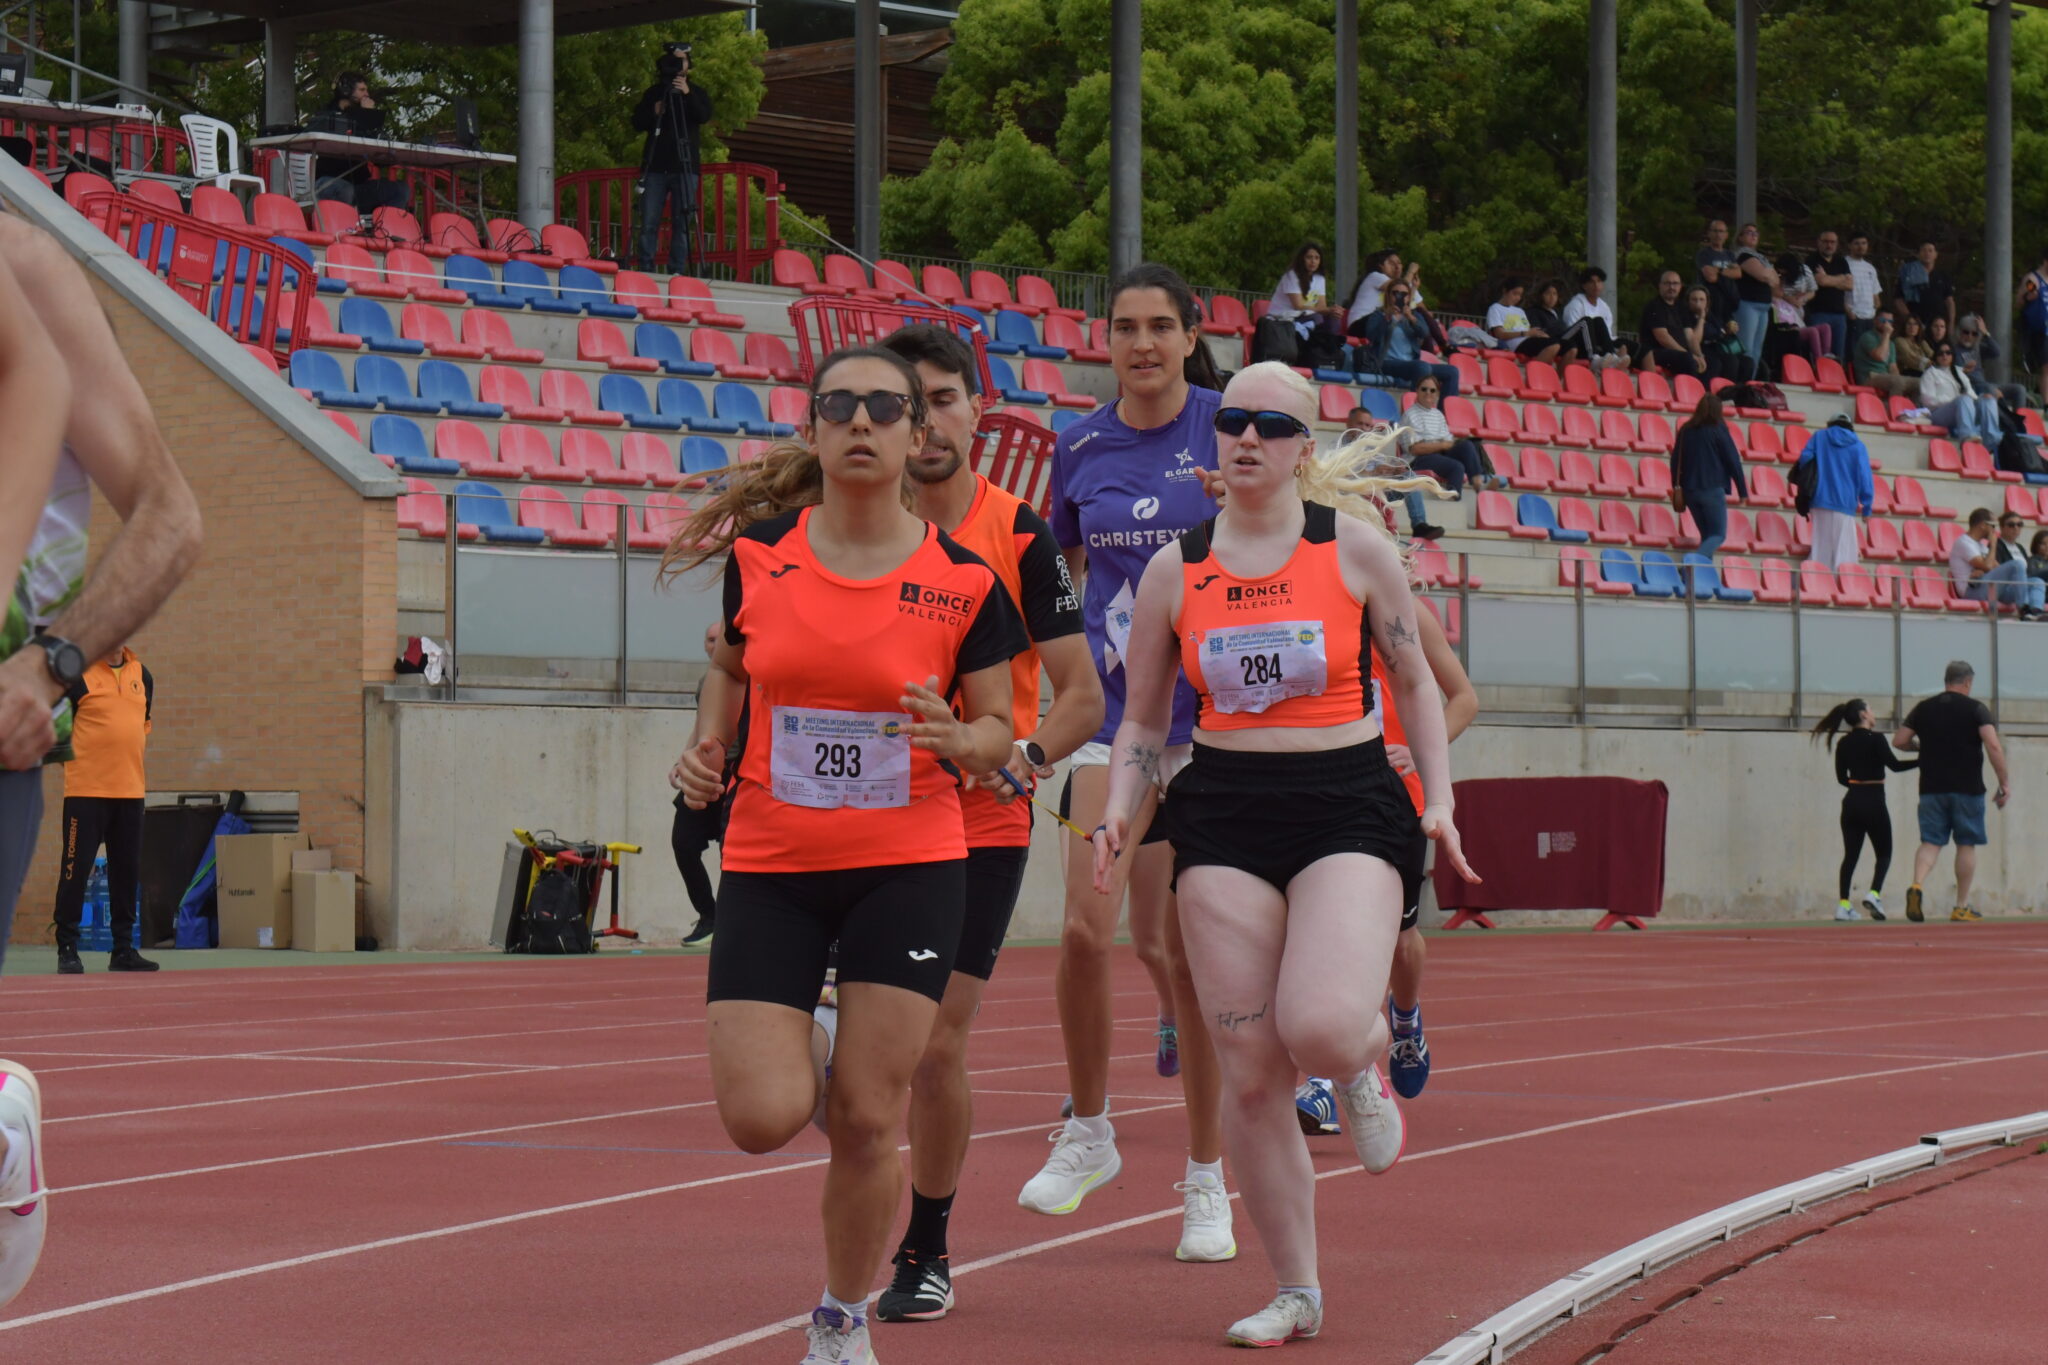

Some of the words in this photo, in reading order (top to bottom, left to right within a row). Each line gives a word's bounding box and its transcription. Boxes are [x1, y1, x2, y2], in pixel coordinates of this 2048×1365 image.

[1165, 470, 1175, 478] EL
[1245, 583, 1289, 598] ONCE
[923, 590, 971, 613] ONCE
[1227, 598, 1292, 611] VALENCIA
[898, 603, 963, 628] VALENCI
[1250, 630, 1291, 639] INTERNACIONAL
[1240, 653, 1283, 686] 284
[784, 714, 799, 724] 20
[805, 717, 829, 725] MEETING
[829, 719, 875, 728] INTERNACIONAL
[784, 723, 799, 732] 26
[815, 725, 847, 734] Comunidad
[847, 727, 878, 735] Valenciana
[815, 742, 861, 779] 293
[68, 816, 78, 858] TORRENT
